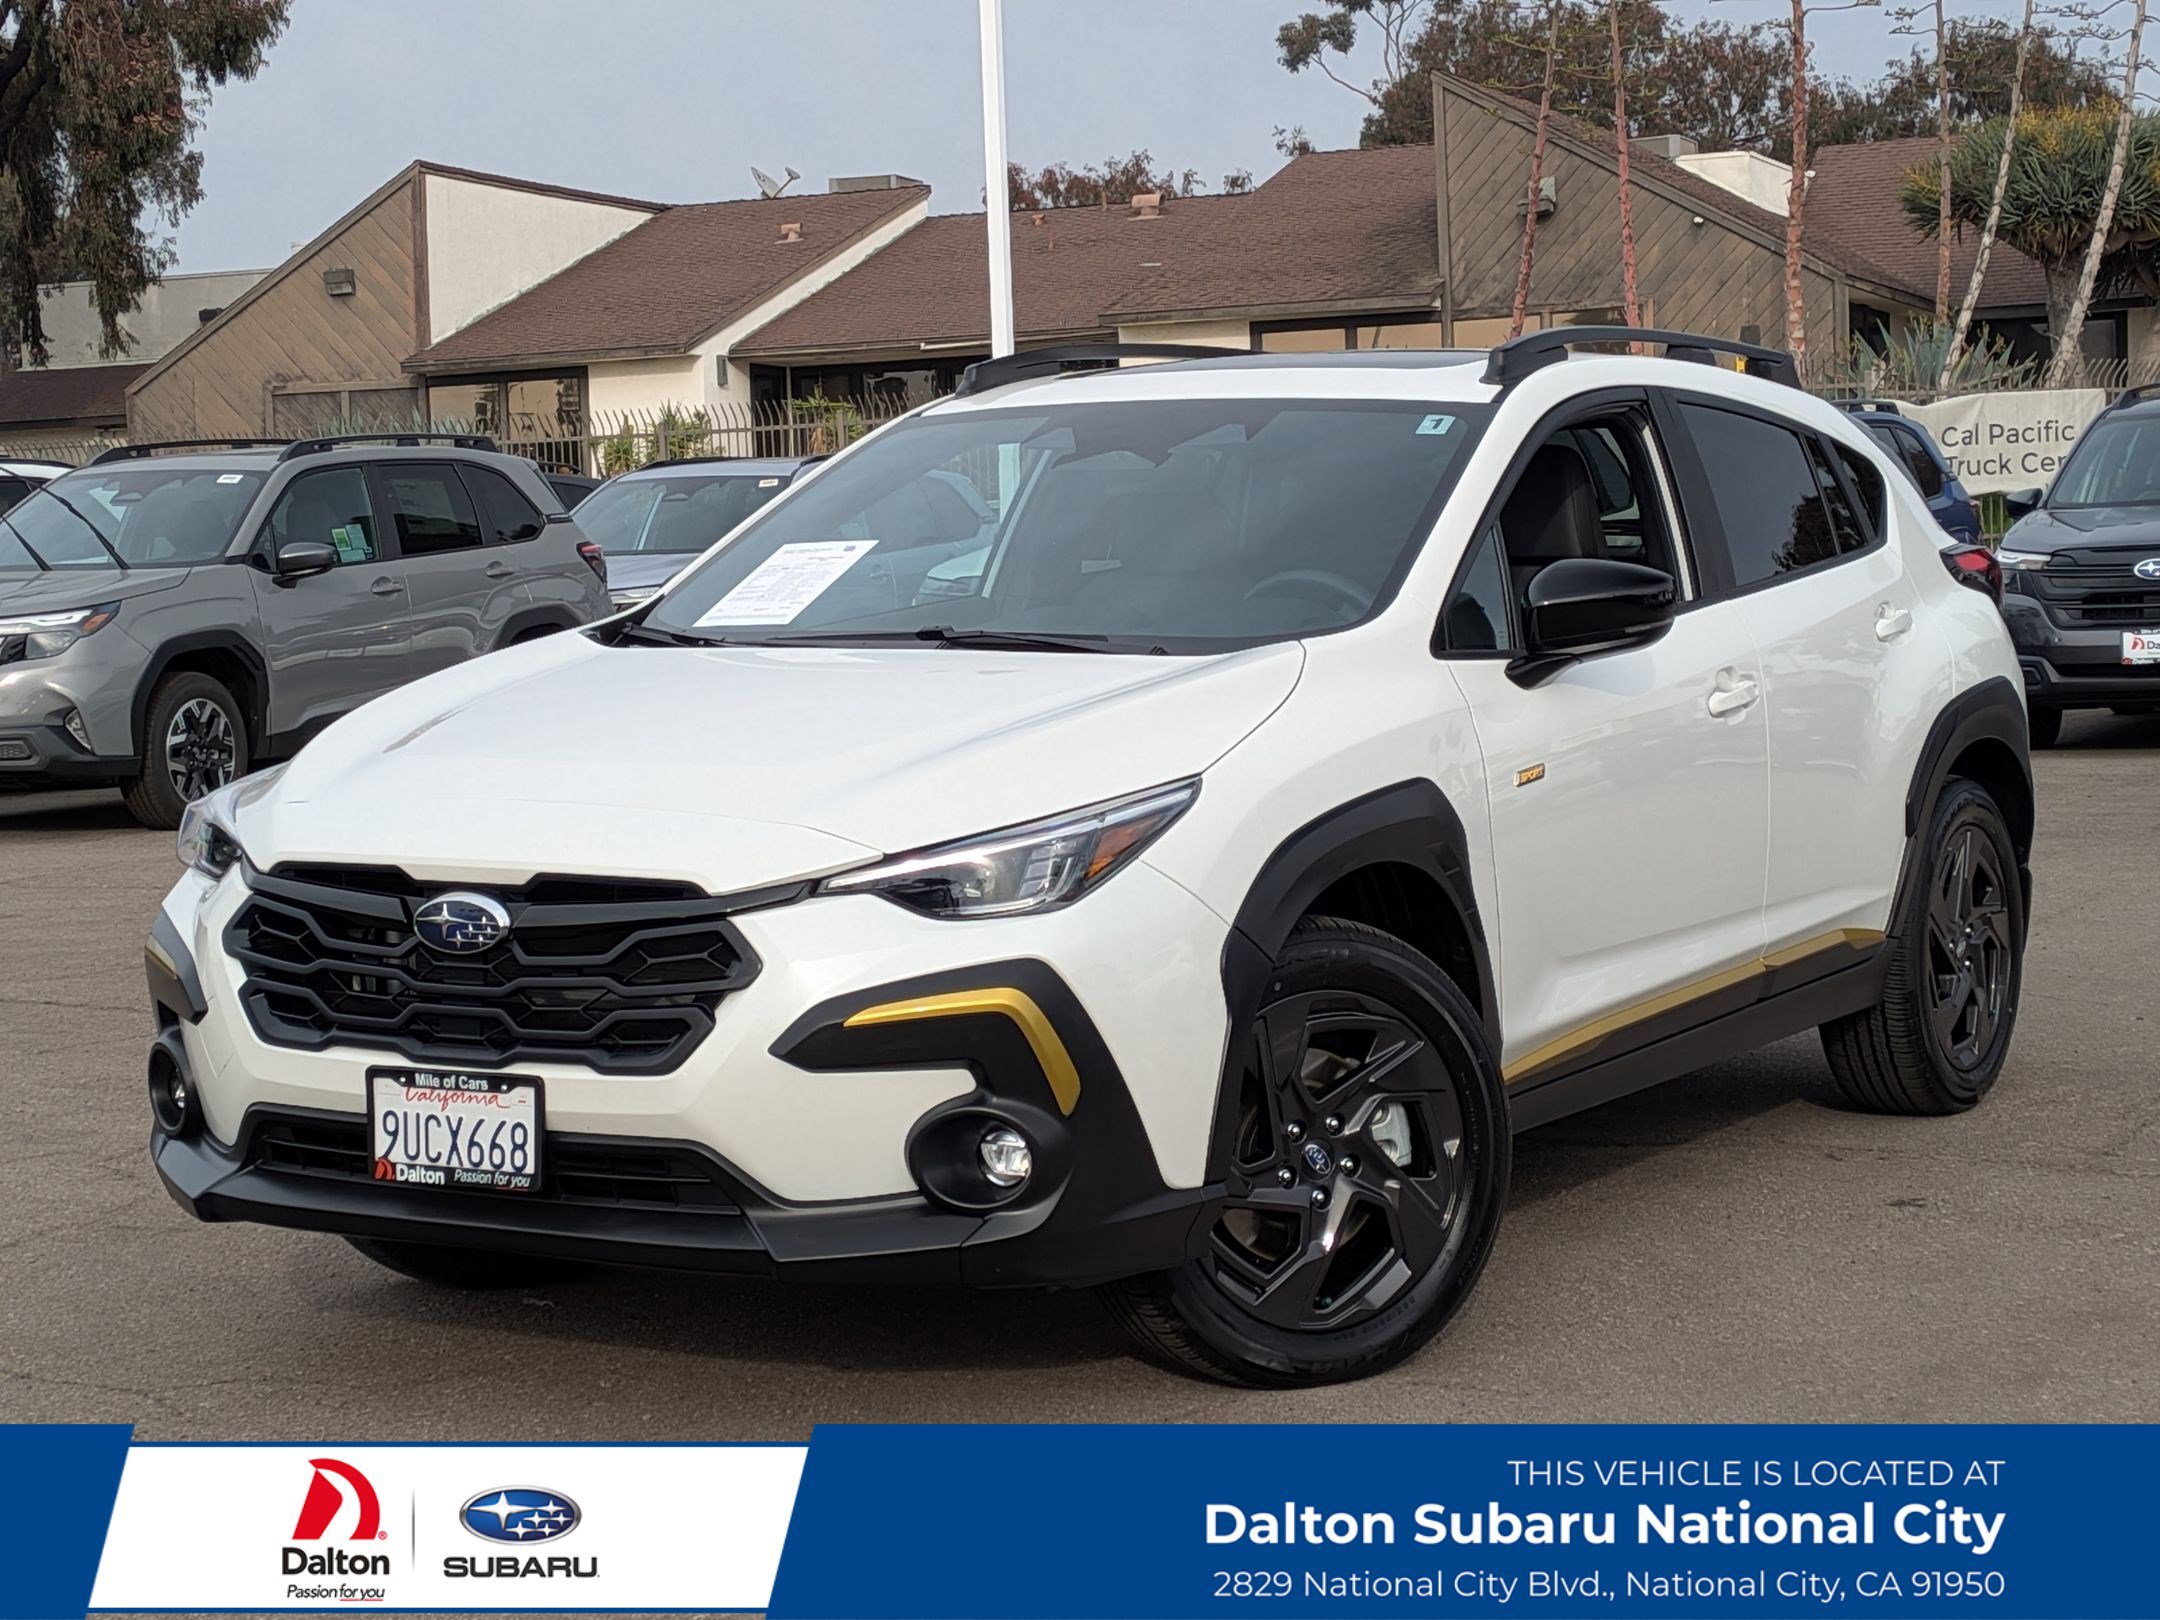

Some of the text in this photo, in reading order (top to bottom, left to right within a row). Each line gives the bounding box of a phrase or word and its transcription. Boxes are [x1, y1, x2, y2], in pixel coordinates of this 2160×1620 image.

[1941, 420, 2075, 447] Cal Pacific
[1945, 453, 2013, 477] Truck
[415, 1073, 489, 1091] Mile of Cars
[405, 1086, 511, 1112] California
[382, 1110, 529, 1174] 9UCX668
[396, 1164, 531, 1188] Dalton Passion for you
